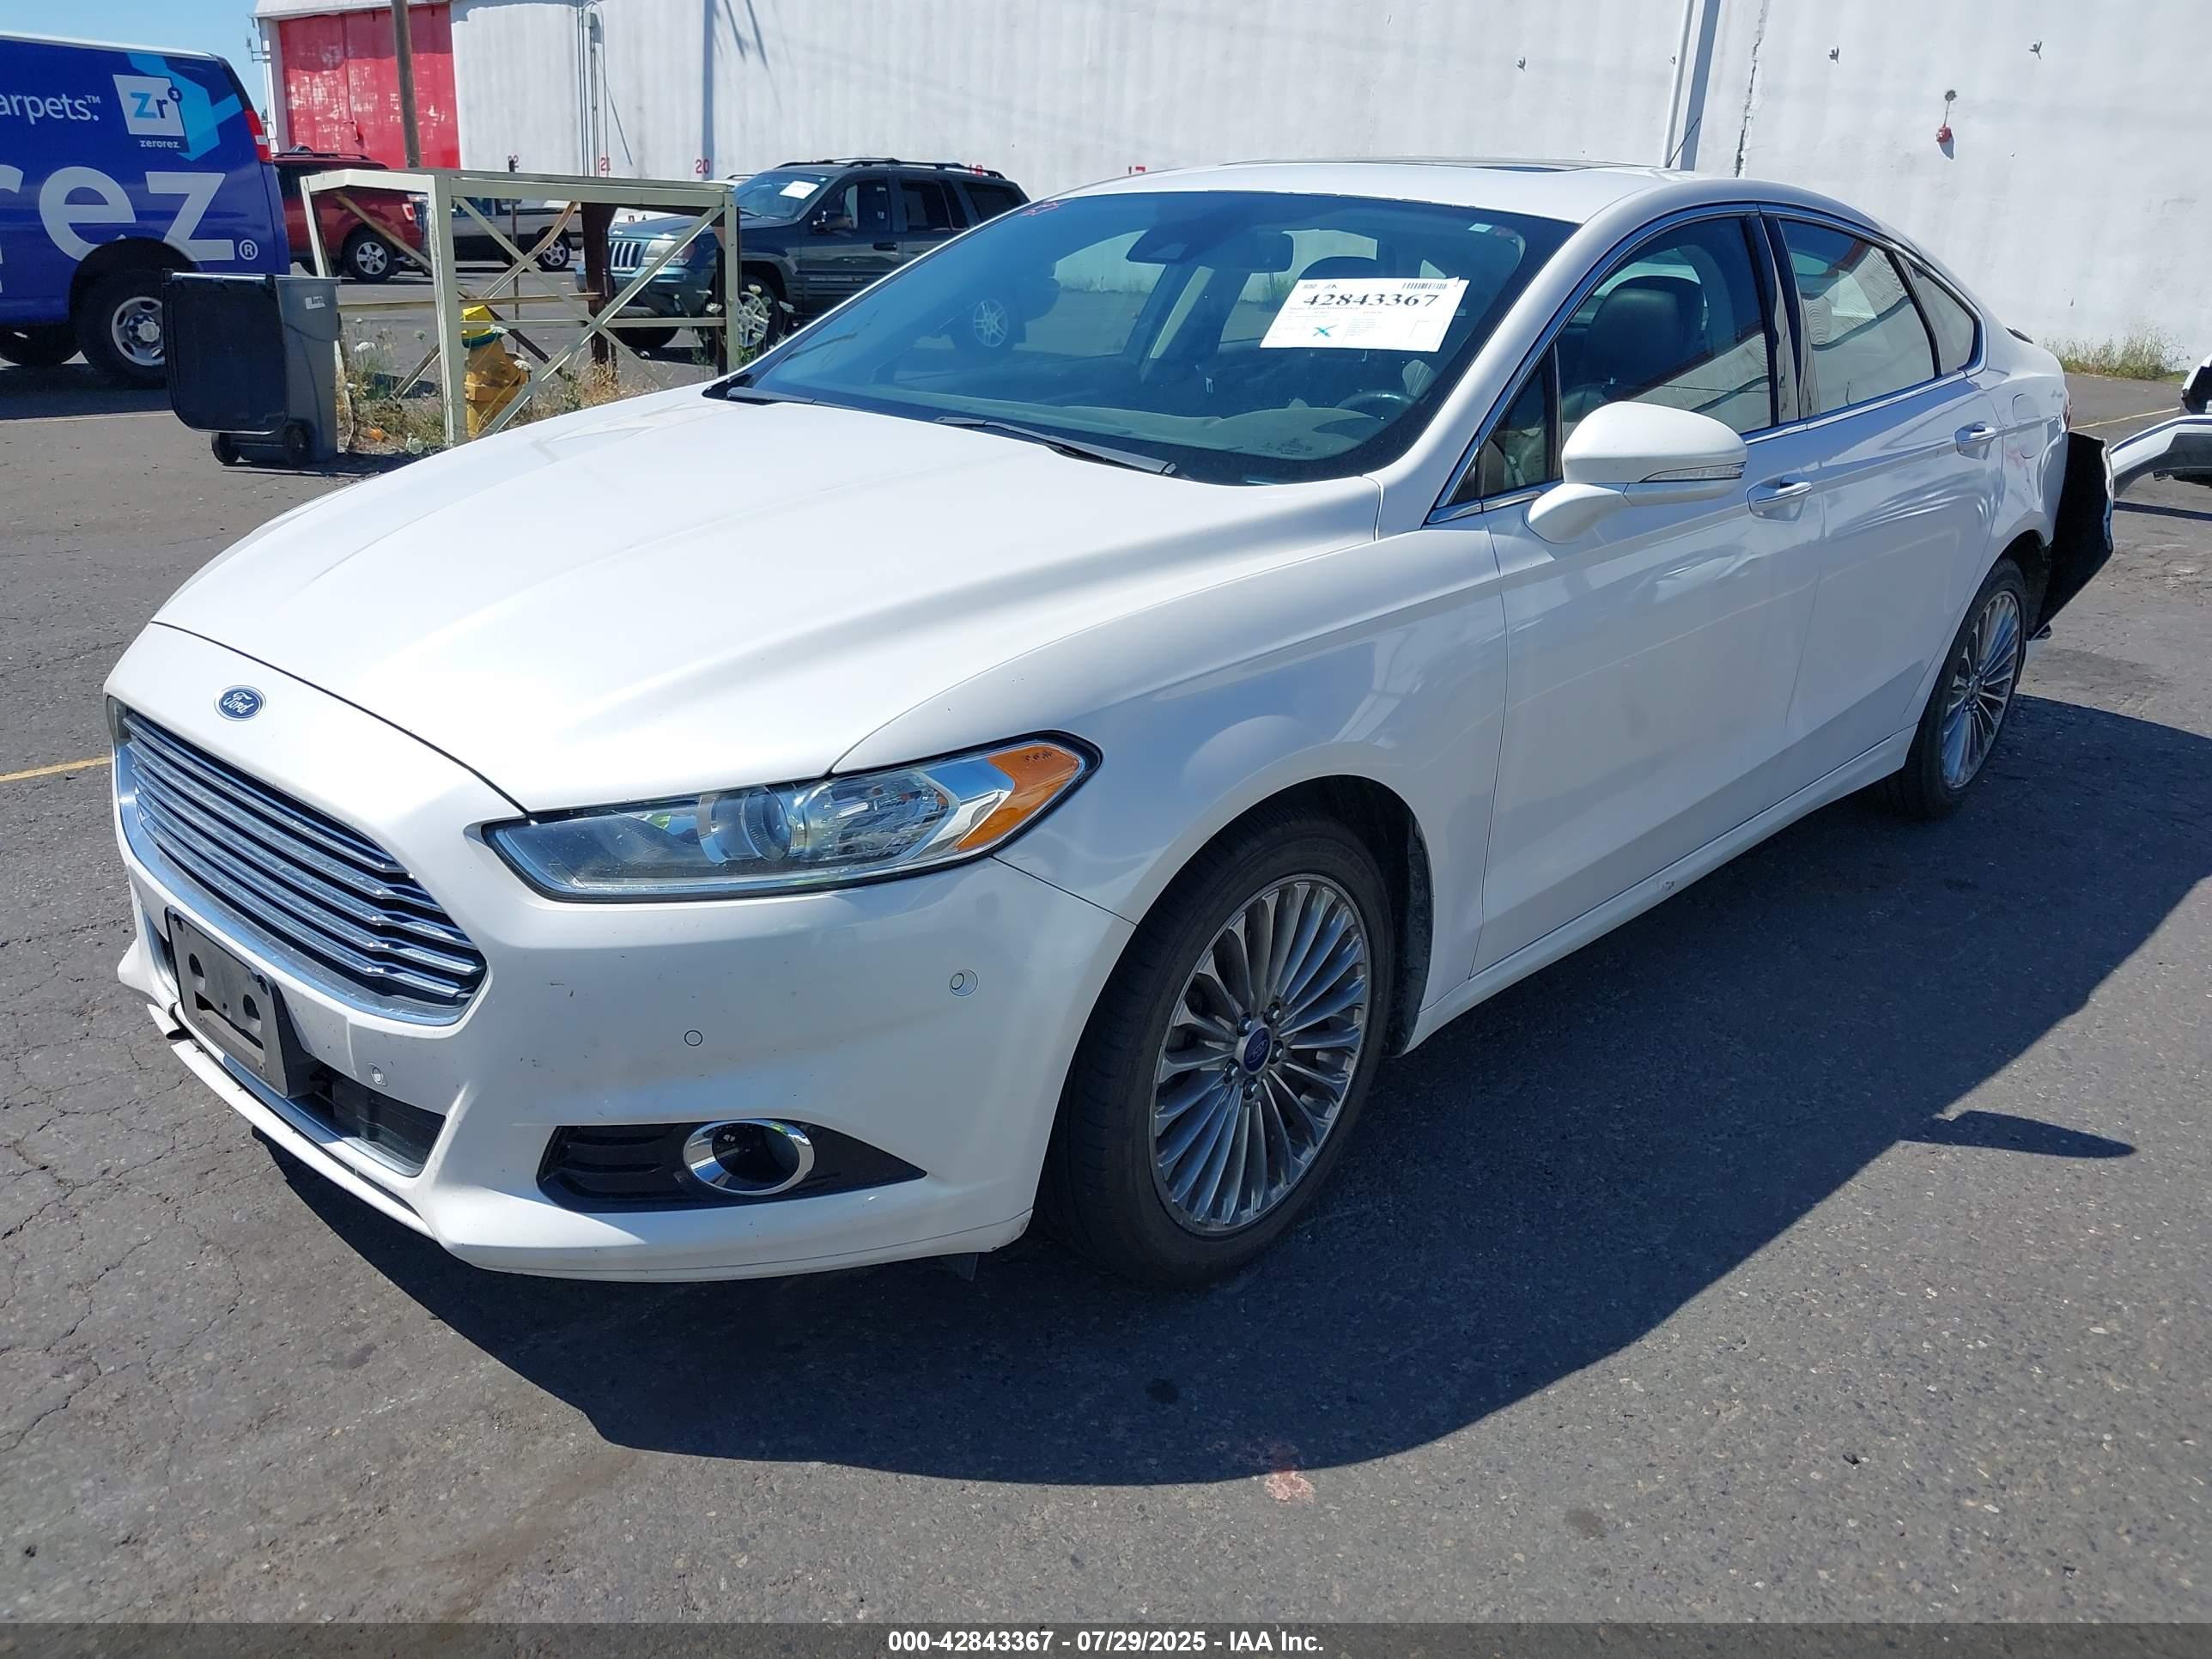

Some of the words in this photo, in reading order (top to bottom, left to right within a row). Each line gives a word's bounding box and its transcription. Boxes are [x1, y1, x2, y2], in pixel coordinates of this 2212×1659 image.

[139, 139, 180, 149] zerorez
[695, 158, 710, 173] 20
[1303, 293, 1439, 307] 42843367
[223, 691, 255, 714] Ford
